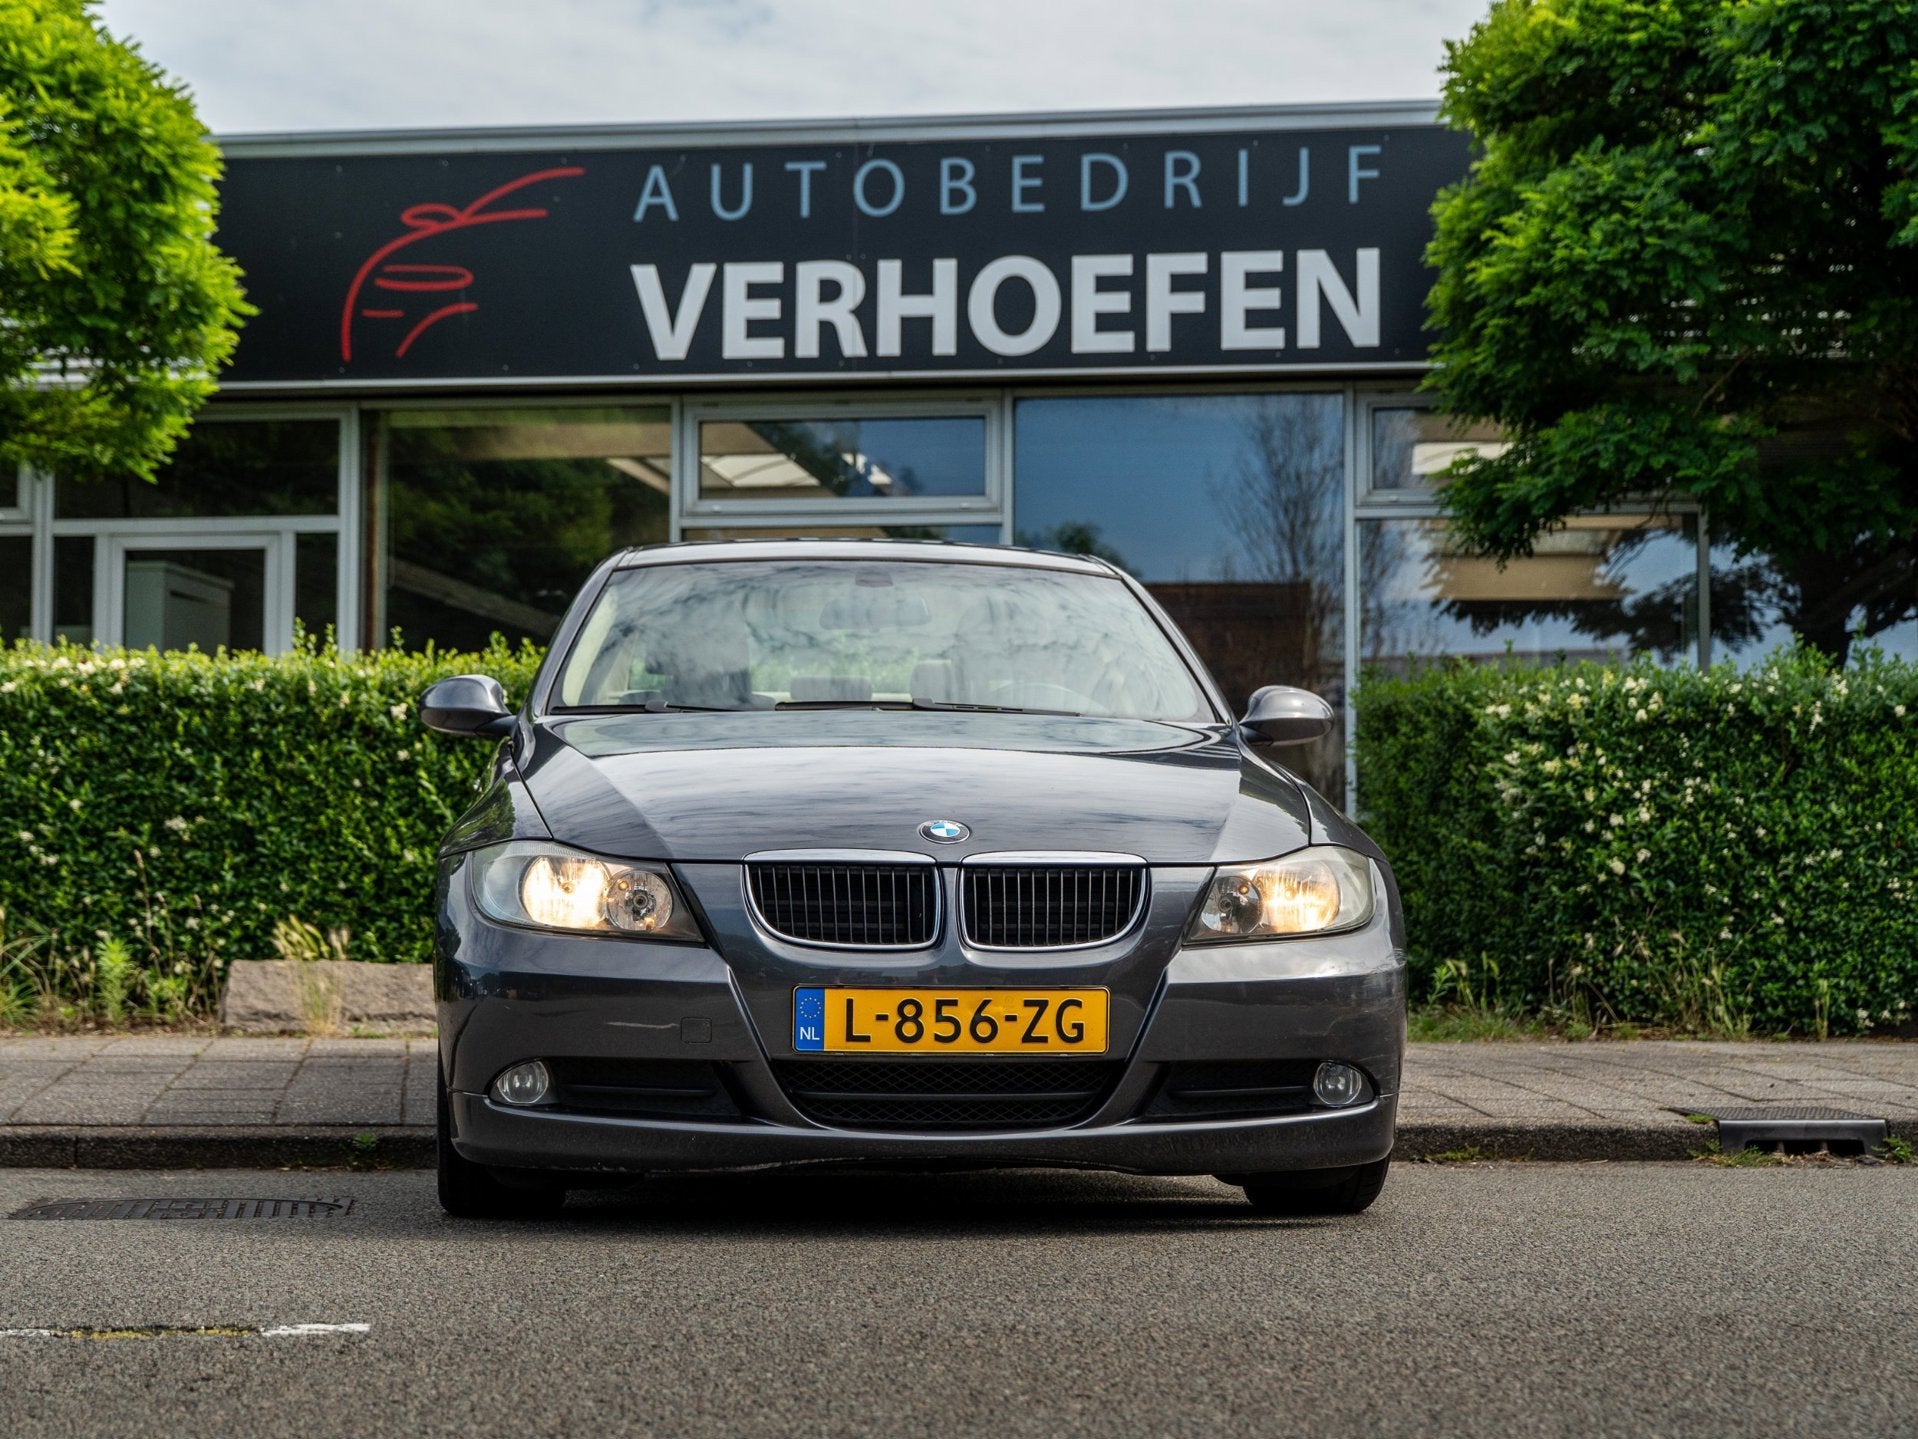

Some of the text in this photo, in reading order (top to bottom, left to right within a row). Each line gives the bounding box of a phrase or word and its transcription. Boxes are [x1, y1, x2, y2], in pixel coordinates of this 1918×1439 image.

[632, 144, 1384, 223] AUTOBEDRIJF
[629, 247, 1382, 361] VERHOEFEN
[799, 1026, 821, 1041] NL
[844, 997, 1085, 1044] L-856-ZG
